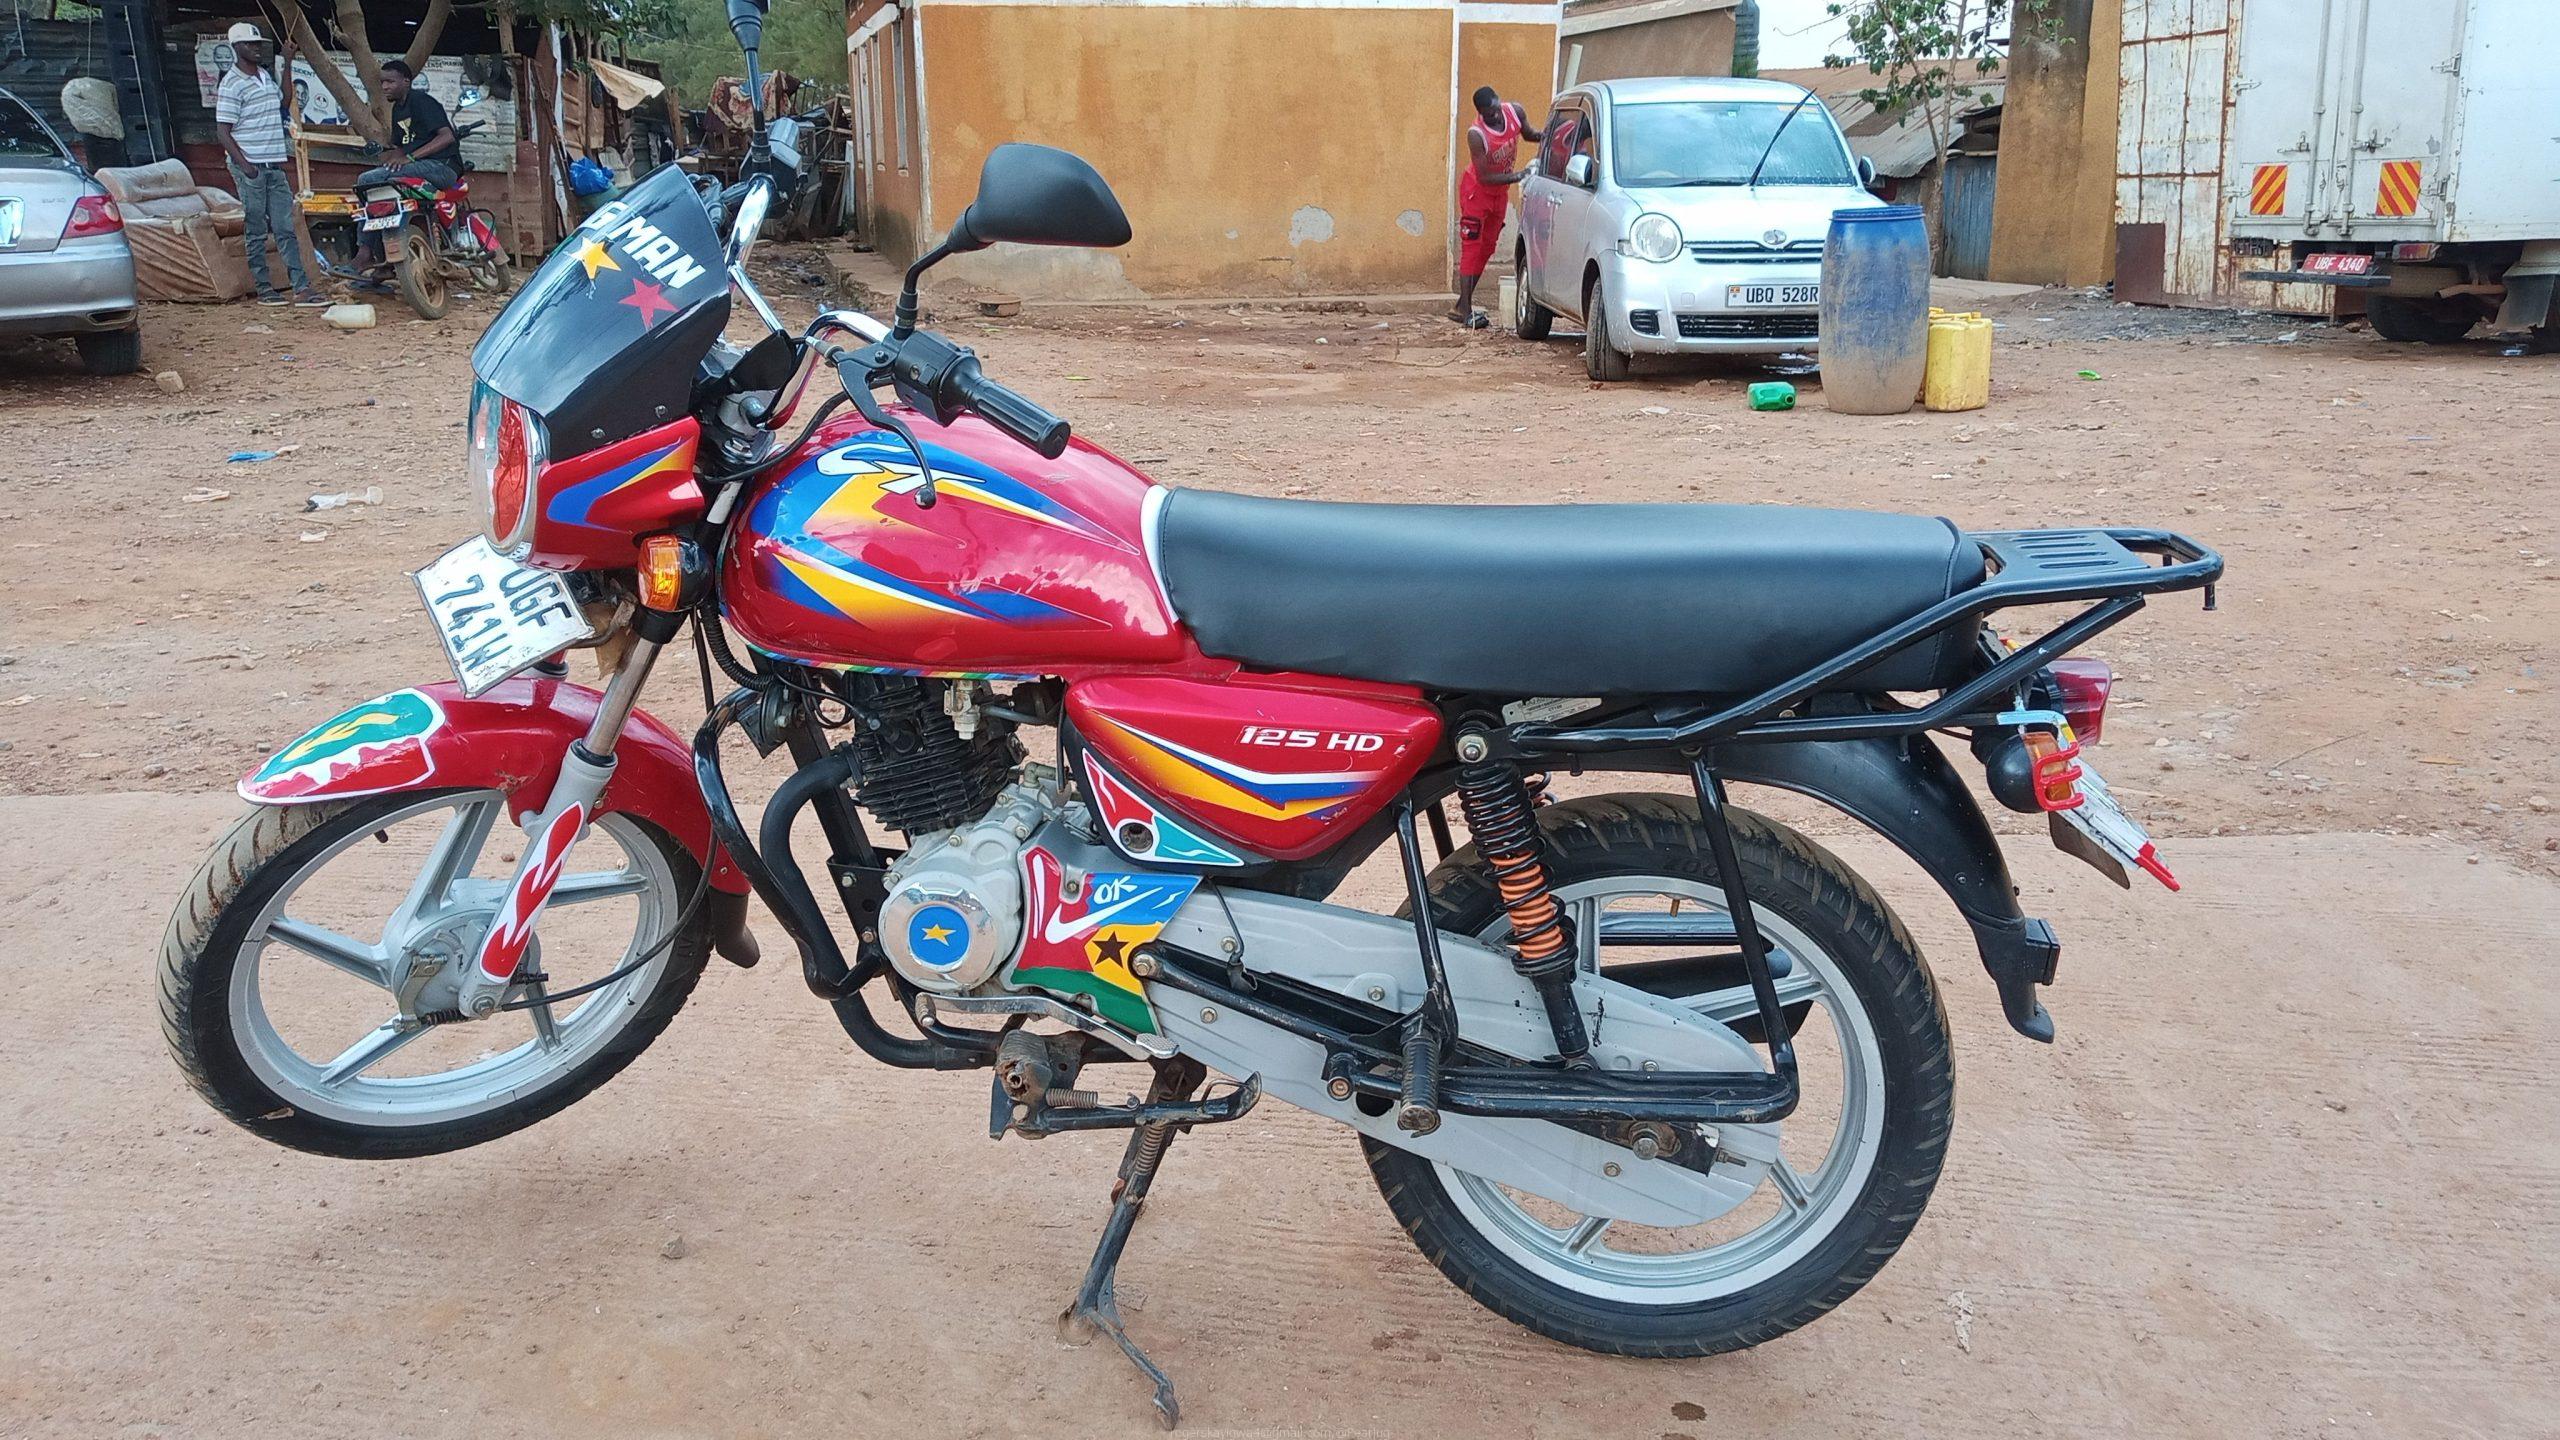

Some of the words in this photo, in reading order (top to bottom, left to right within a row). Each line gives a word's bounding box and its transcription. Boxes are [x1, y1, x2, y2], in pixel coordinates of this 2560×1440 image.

[608, 215, 706, 289] MAN
[2314, 256, 2336, 270] UBF
[1746, 287, 1774, 303] UBQ
[1782, 286, 1819, 303] 528R
[499, 568, 572, 627] UGF
[435, 574, 513, 672] 741W
[1240, 726, 1320, 748] 125
[1326, 733, 1384, 752] HD
